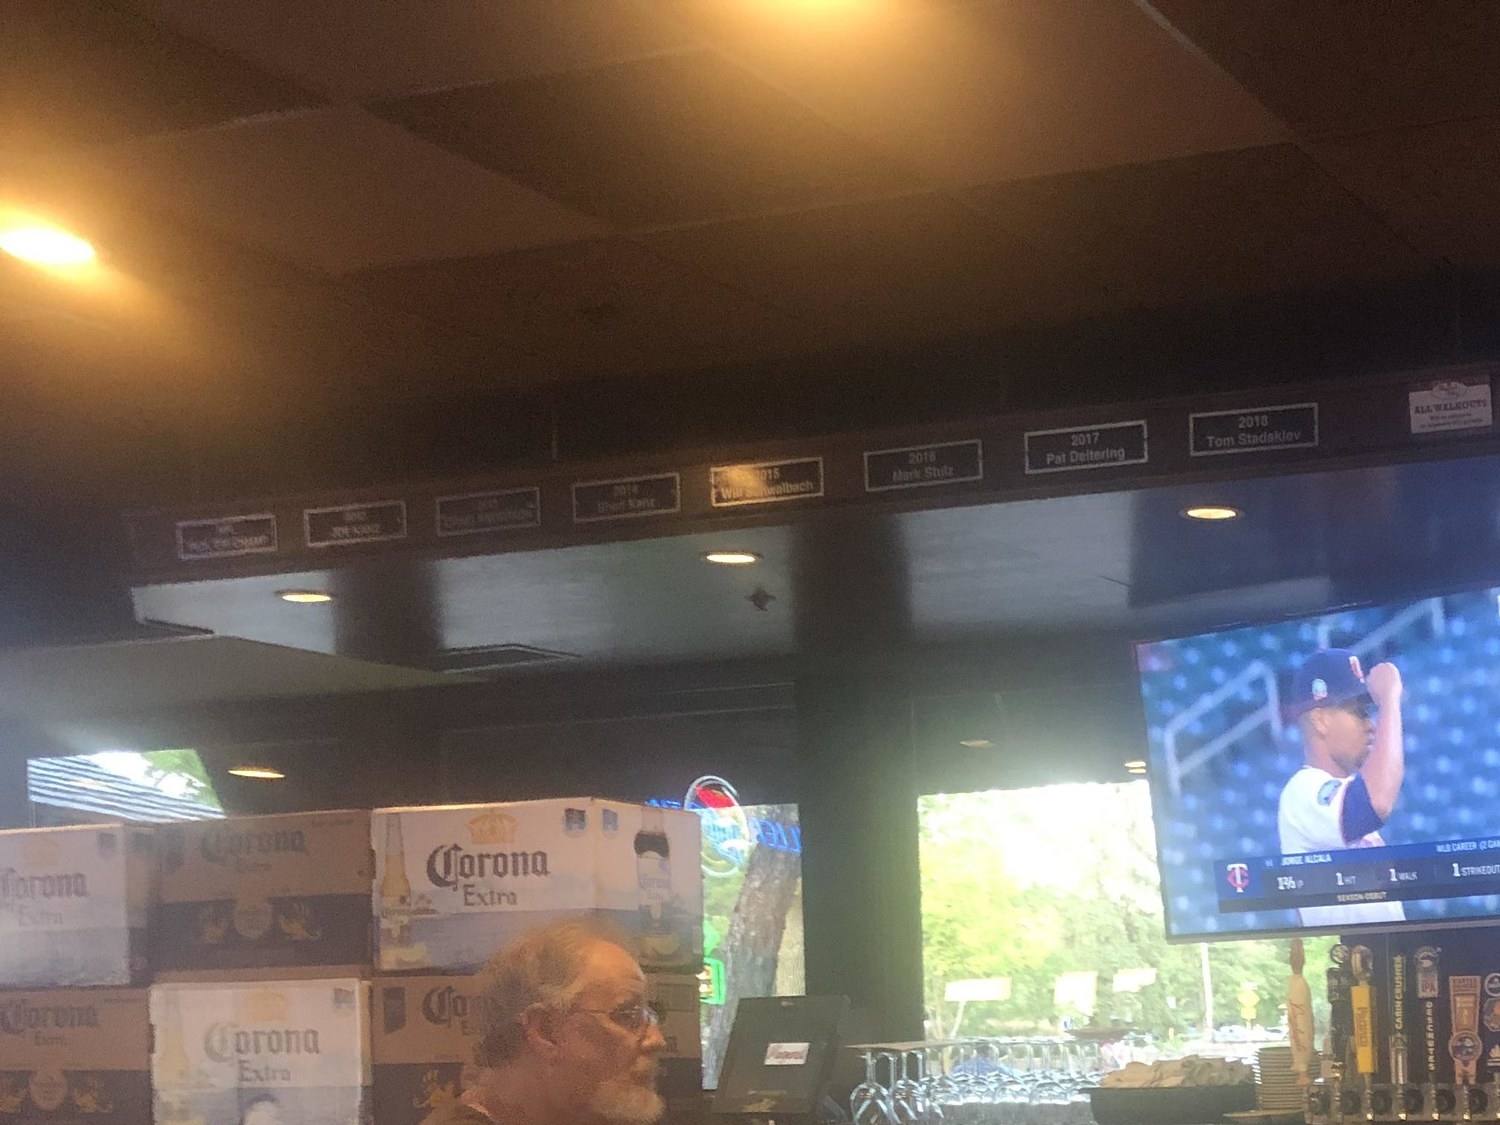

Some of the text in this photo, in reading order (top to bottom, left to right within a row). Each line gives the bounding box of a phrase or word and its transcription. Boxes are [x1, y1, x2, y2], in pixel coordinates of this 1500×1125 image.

[1415, 404, 1432, 414] ALL
[1238, 416, 1268, 429] 2018
[1071, 432, 1100, 446] 2017
[1207, 435, 1235, 447] Tom
[1046, 452, 1068, 465] Pat
[744, 479, 815, 496] Shwalbach
[427, 843, 550, 891] Corona
[1452, 864, 1500, 876] 1 STRIKEOUT
[1336, 873, 1357, 886] 1 HIT
[1390, 869, 1398, 881] 1
[463, 884, 518, 907] Extra
[19, 904, 63, 926] Extra
[1421, 982, 1437, 993] IPA
[1394, 1000, 1404, 1030] CABIN
[1425, 1001, 1437, 1071] DESCHUTES
[204, 1021, 320, 1067] Corona
[237, 1059, 291, 1082] Extra
